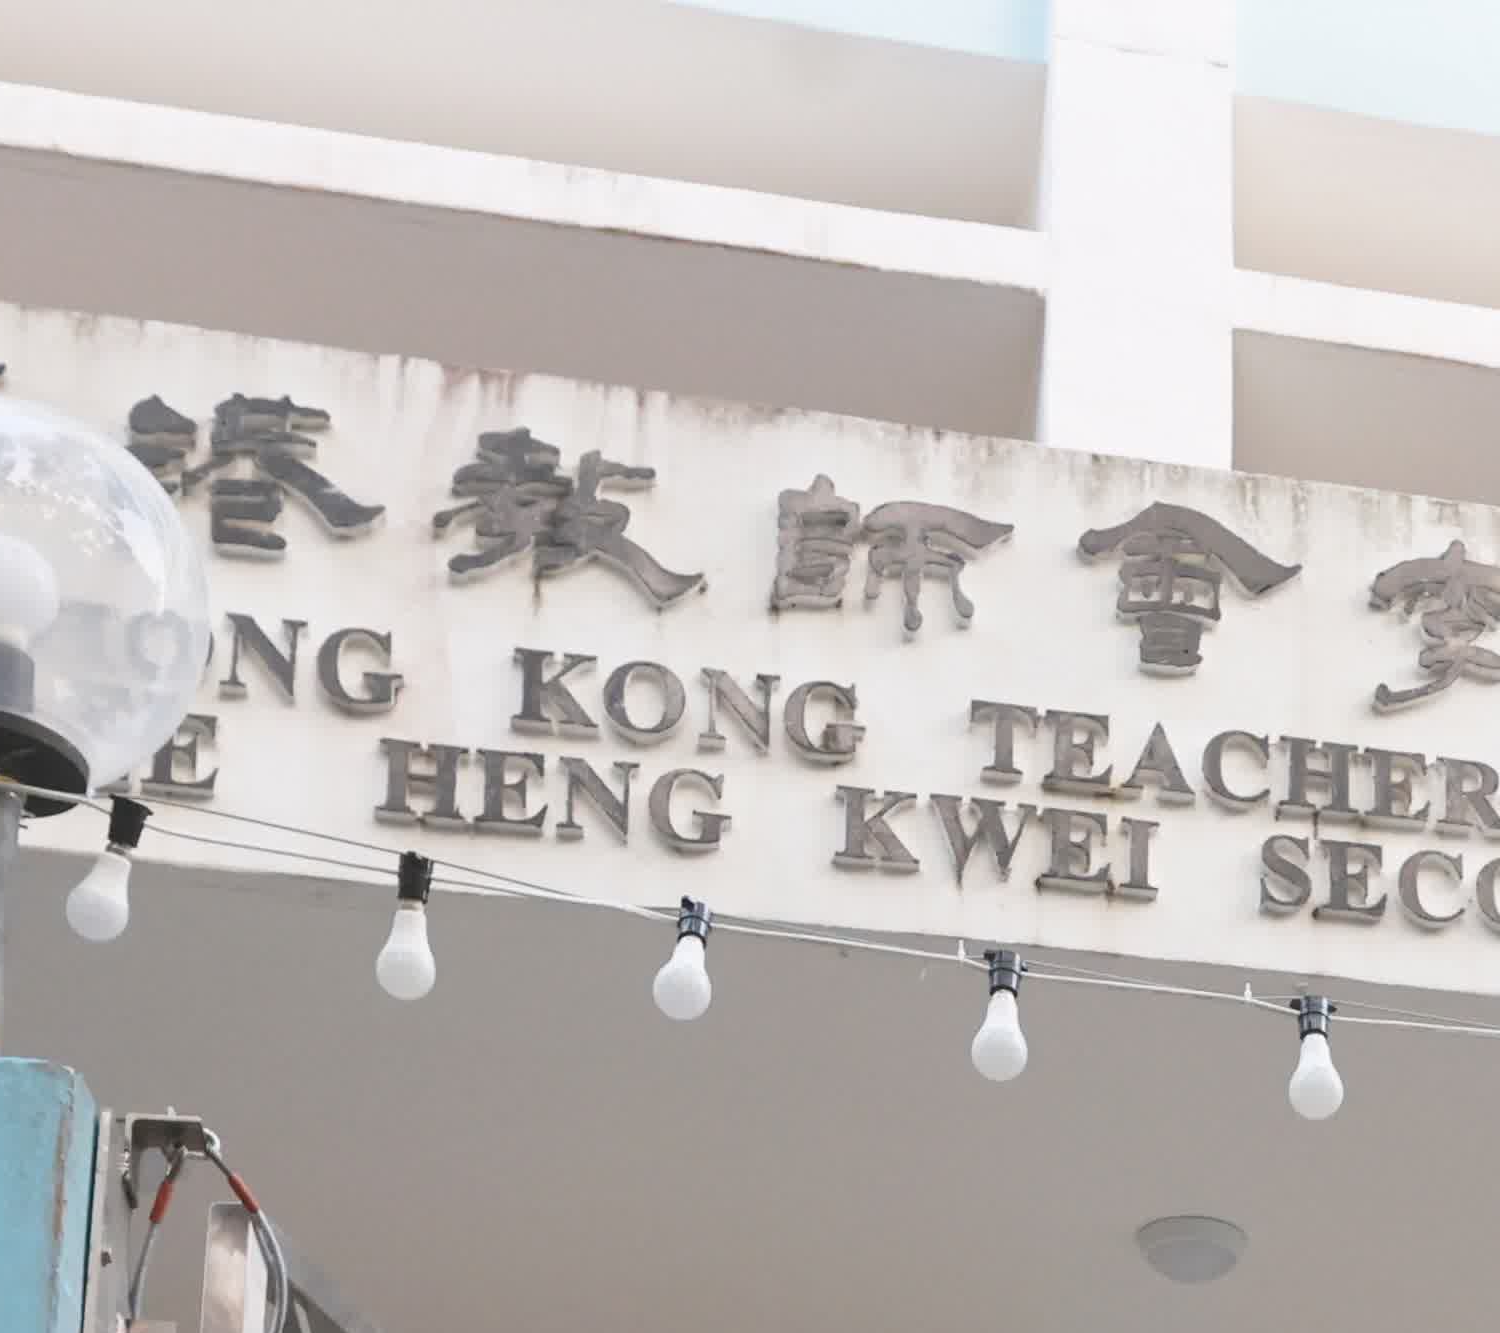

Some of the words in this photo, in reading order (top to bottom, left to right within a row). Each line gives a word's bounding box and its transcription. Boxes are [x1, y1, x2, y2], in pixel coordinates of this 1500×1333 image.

[512, 648, 866, 766] KONG
[376, 738, 733, 856] HENG
[832, 784, 1160, 899] KWEI
